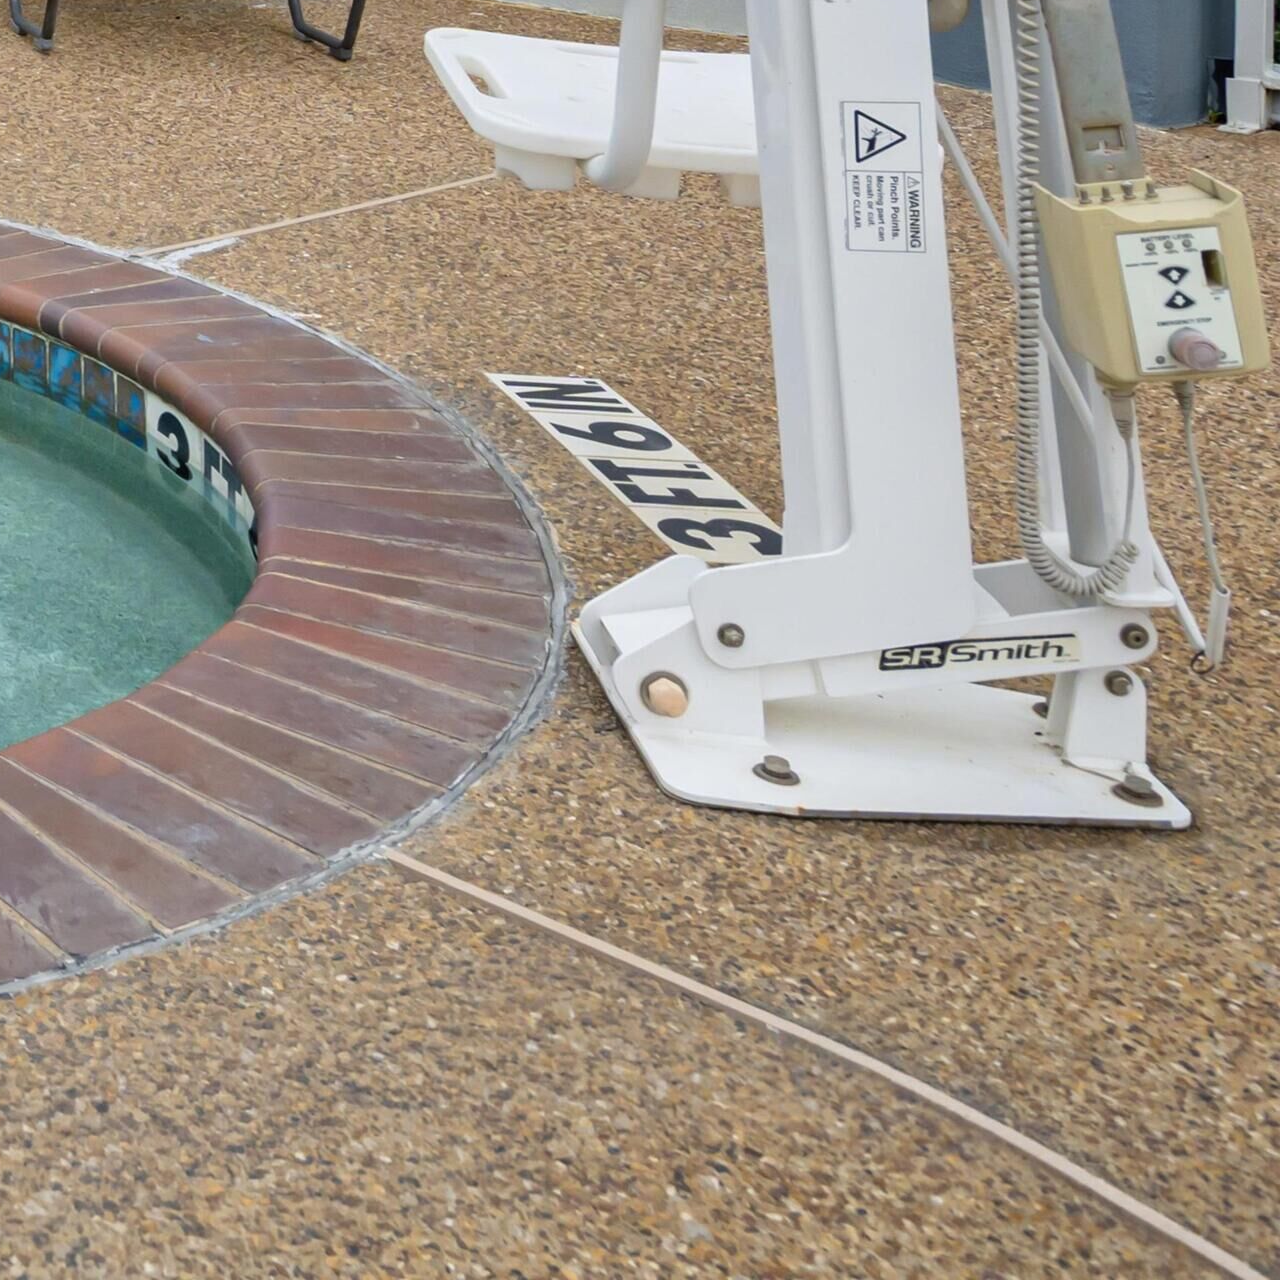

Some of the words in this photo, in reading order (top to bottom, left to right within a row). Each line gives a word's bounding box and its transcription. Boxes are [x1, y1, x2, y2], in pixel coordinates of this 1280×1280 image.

[852, 175, 861, 197] KEEP
[866, 175, 874, 199] crush
[876, 176, 884, 206] Moving
[890, 176, 899, 203] Pinch
[867, 200, 874, 209] or
[876, 208, 885, 224] part
[908, 190, 922, 248] WARNING
[891, 206, 901, 240] Points.
[1141, 235, 1170, 243] BATTERY
[1157, 318, 1194, 327] EMERGENCY
[502, 379, 634, 413] IN.
[156, 411, 193, 481] 3
[550, 421, 672, 451] 6
[587, 458, 747, 510] FT.
[657, 518, 783, 555] 3
[882, 645, 946, 669] SR
[948, 640, 1066, 663] Smith
